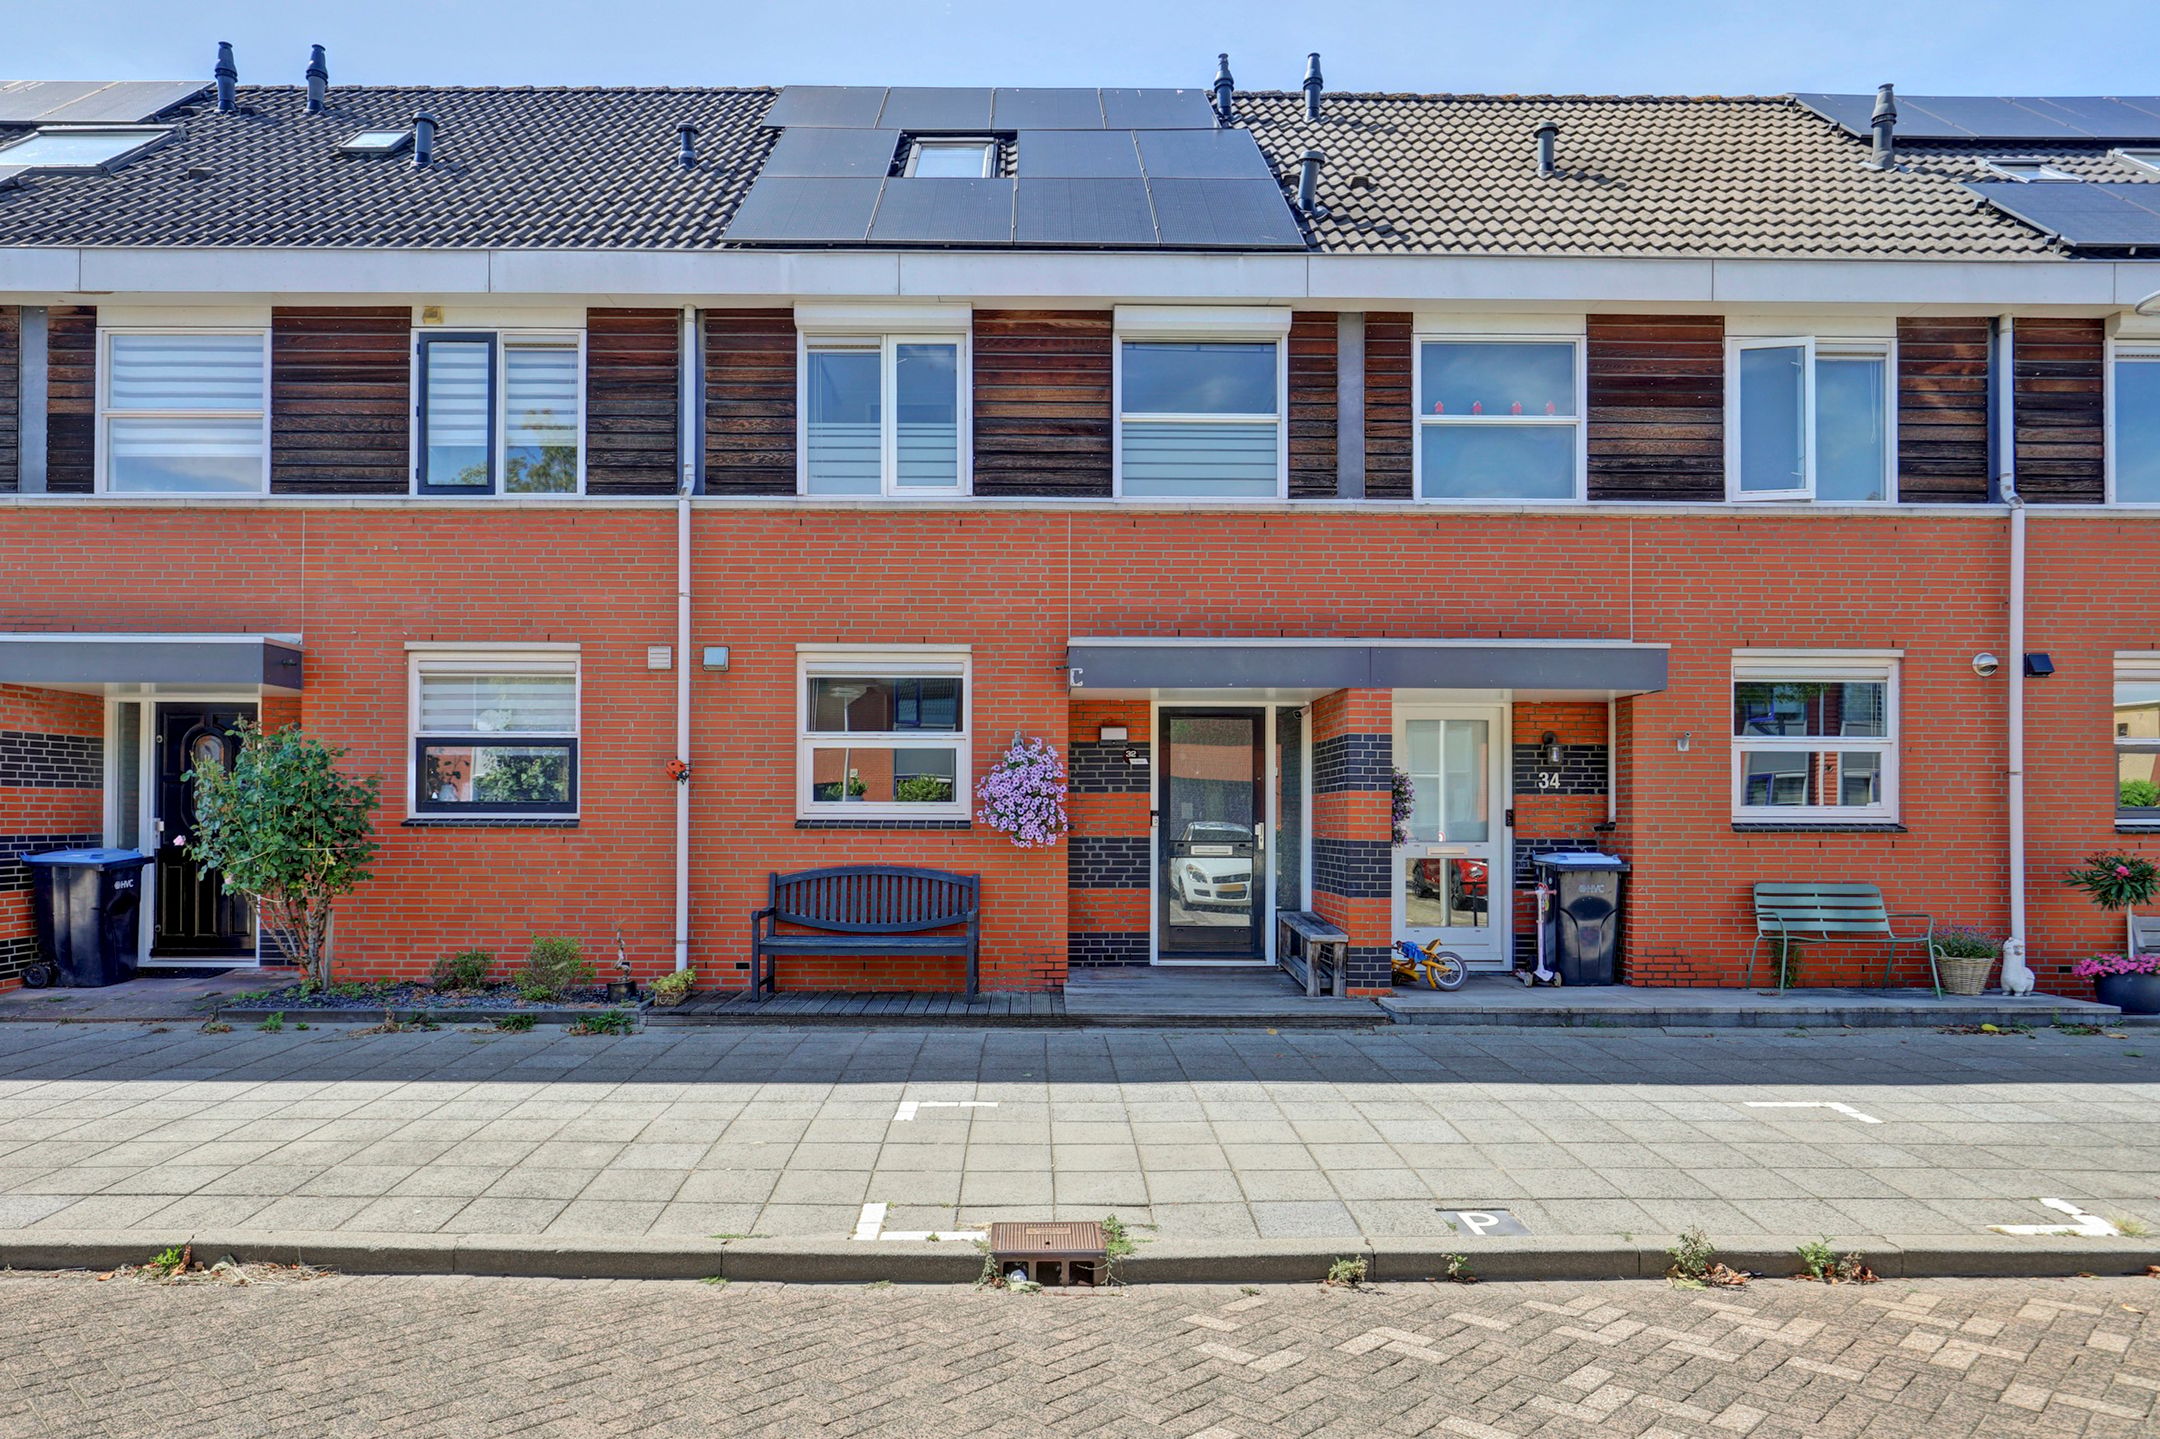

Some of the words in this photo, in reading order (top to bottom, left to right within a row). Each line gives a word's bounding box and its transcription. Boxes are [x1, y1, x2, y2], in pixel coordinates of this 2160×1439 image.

[1125, 750, 1137, 758] 32
[1538, 772, 1561, 789] 34
[120, 879, 134, 889] HVC
[1457, 1212, 1499, 1235] P
